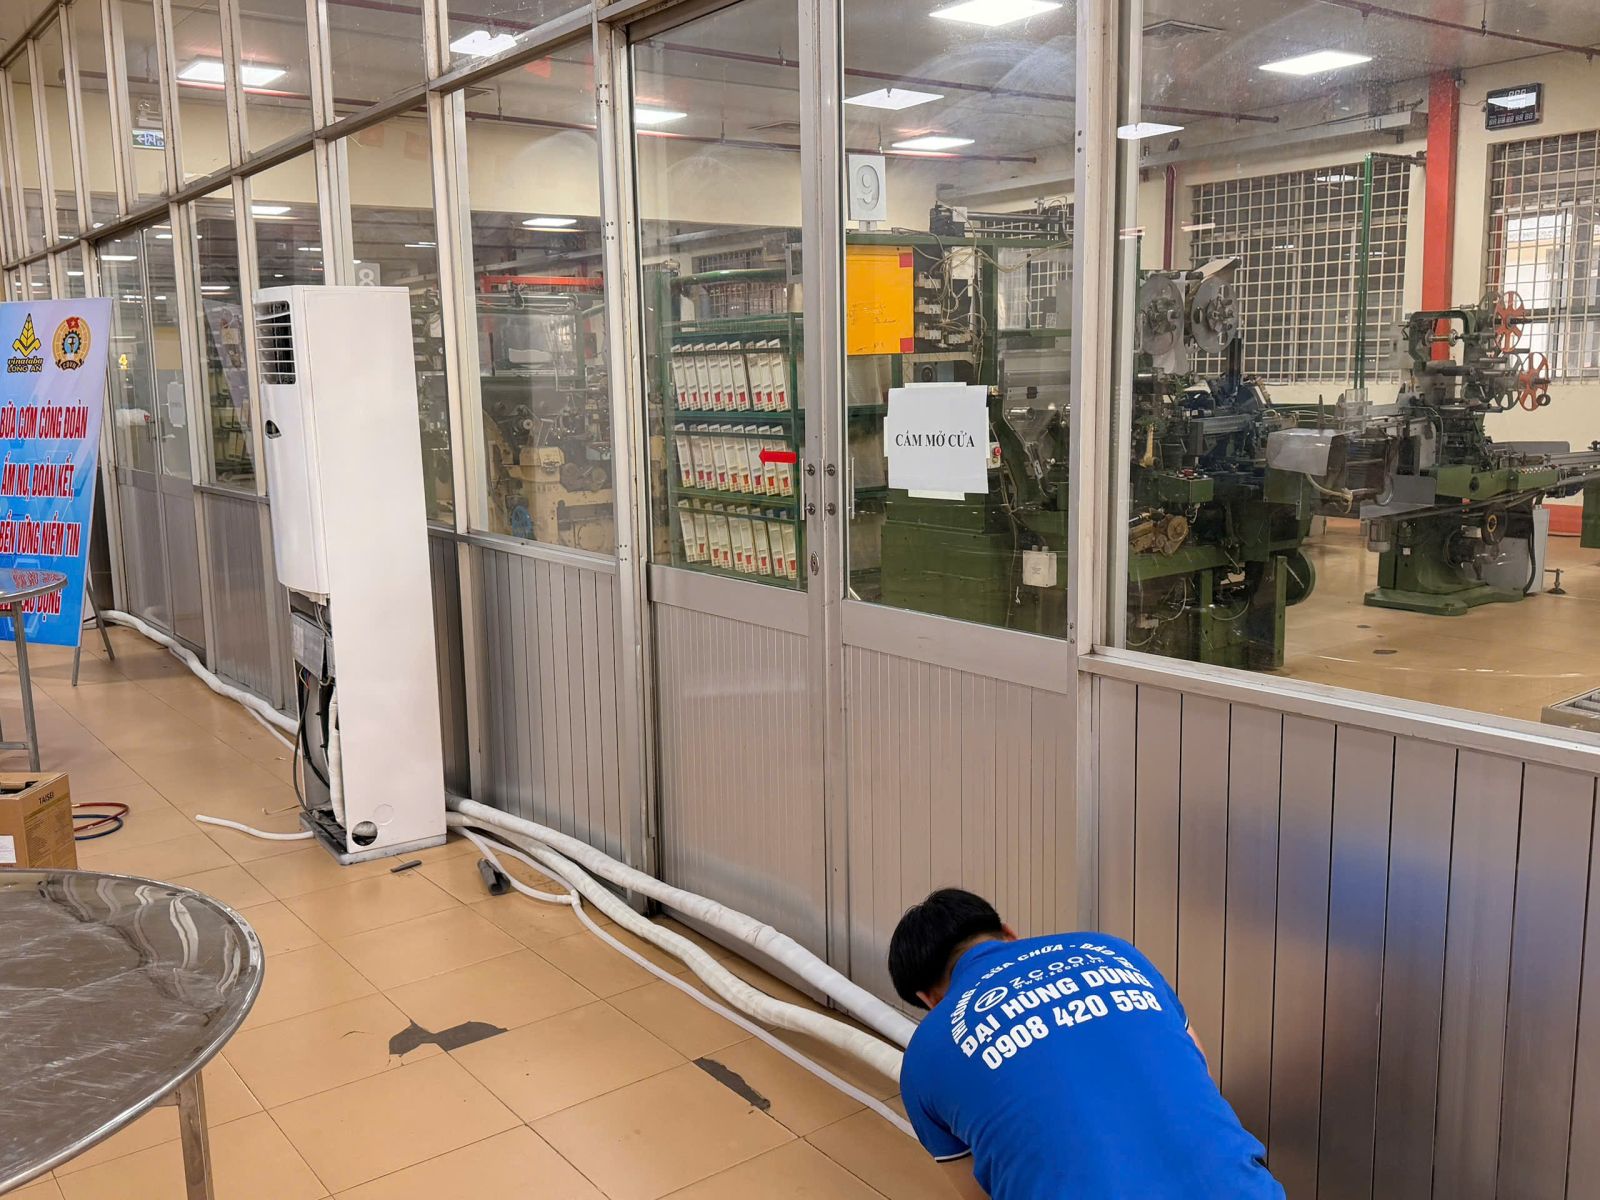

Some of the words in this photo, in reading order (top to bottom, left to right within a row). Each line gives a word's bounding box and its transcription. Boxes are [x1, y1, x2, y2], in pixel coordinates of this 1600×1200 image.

[856, 164, 880, 211] 9
[0, 400, 17, 438] BỮA
[18, 403, 38, 438] CƠM
[39, 399, 63, 438] CÔNG
[63, 399, 89, 438] ĐOÀN
[925, 430, 946, 447] MỞ
[948, 430, 975, 447] CỬA
[16, 463, 30, 500] NO,
[32, 456, 57, 497] ĐOÀN
[17, 515, 41, 554] VỮNG
[65, 522, 81, 556] TIN
[960, 1014, 1001, 1057] ĐẠI
[1001, 976, 1079, 1020] HÙNG
[1081, 966, 1154, 990] DŨNG
[981, 1015, 1049, 1070] 0908
[1053, 994, 1109, 1028] 420
[1109, 989, 1162, 1012] 558
